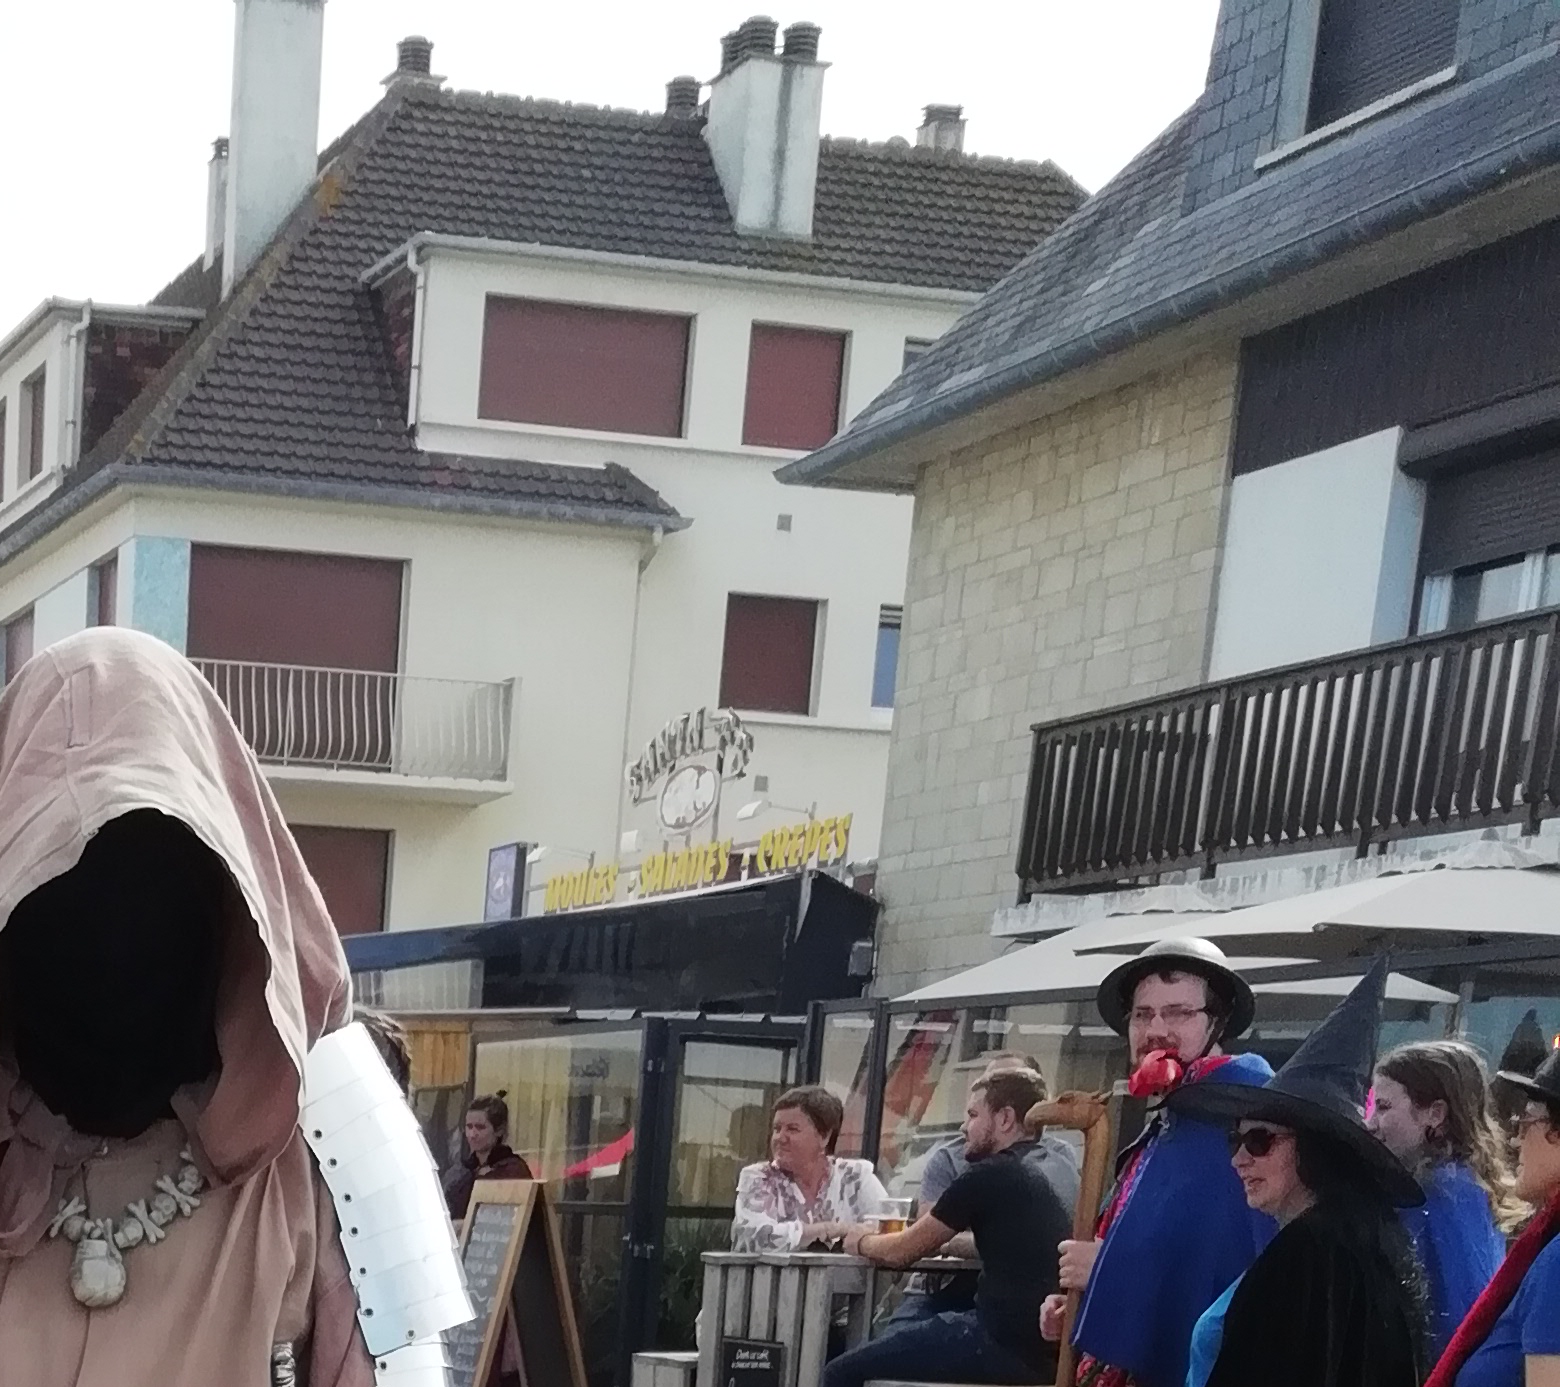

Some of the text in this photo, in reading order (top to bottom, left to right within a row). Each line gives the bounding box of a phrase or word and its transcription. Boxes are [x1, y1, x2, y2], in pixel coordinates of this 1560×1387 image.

[543, 813, 851, 912] MOULES SALADES CREPES
